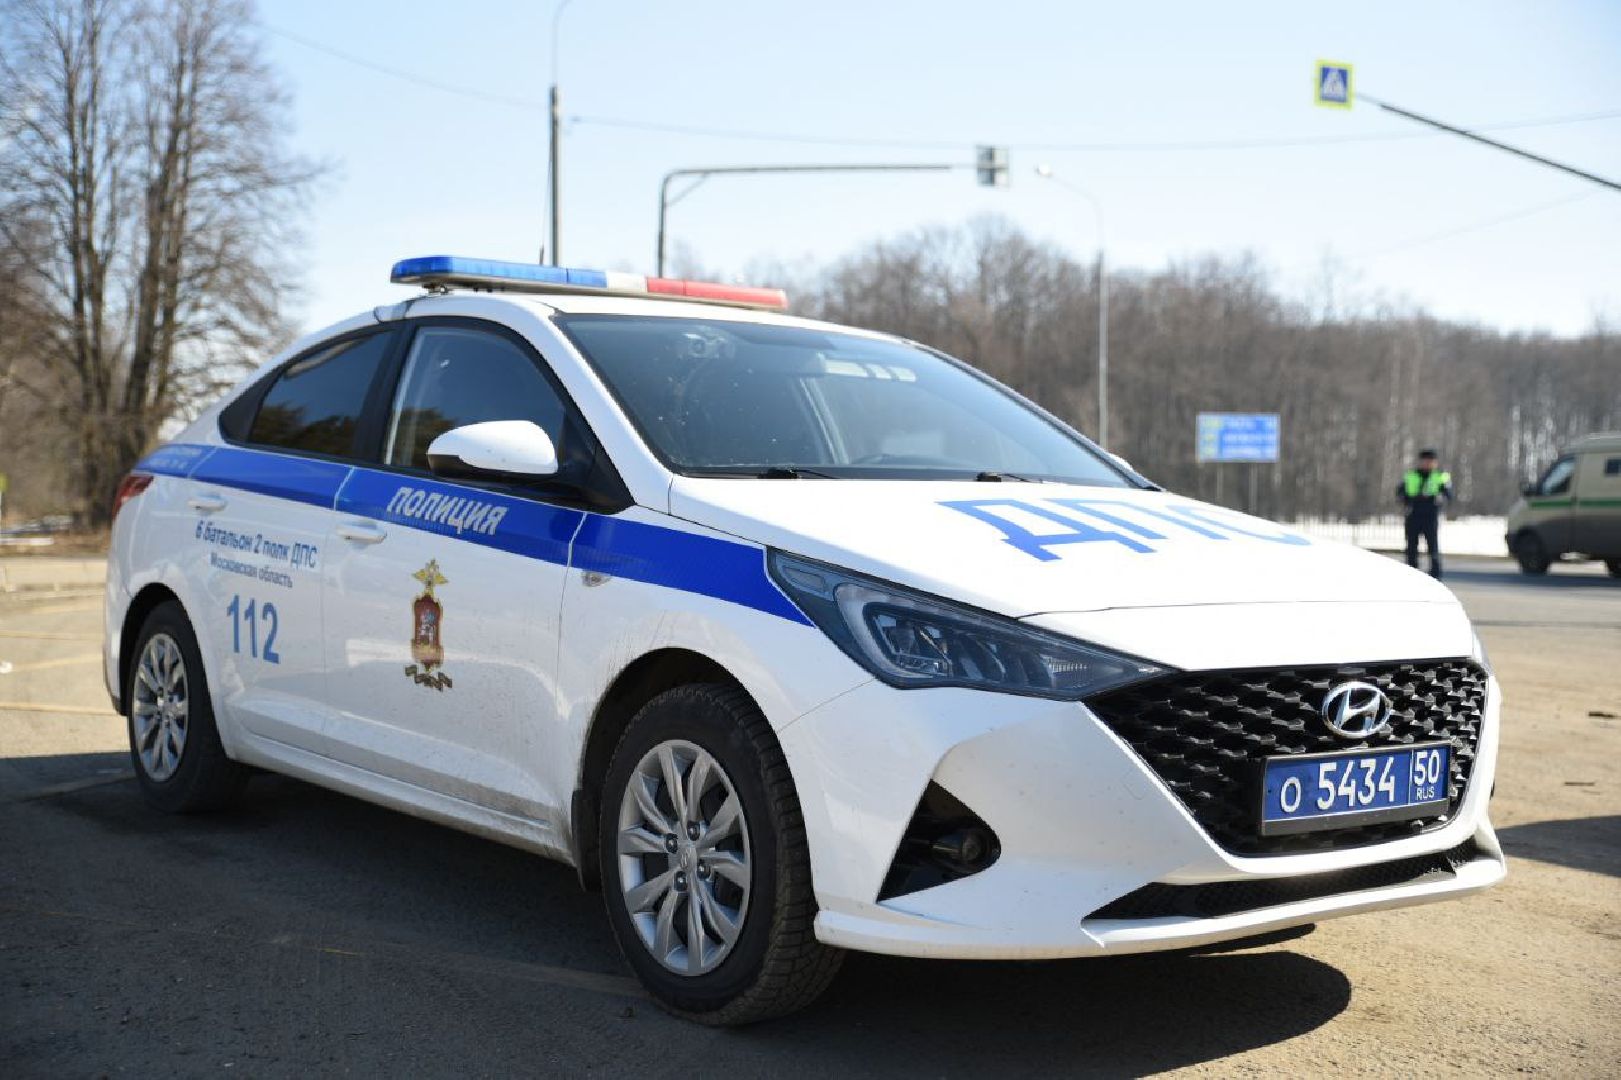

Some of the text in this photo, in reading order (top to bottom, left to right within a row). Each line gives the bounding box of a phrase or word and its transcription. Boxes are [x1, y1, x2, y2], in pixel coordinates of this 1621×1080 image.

[386, 486, 508, 536] ПОЛИЦИЯ
[935, 498, 1312, 563] ДПС
[195, 520, 318, 570] 6 батальон 2 полк ДПС
[210, 552, 293, 588] Московская область
[227, 594, 280, 665] 112
[1317, 757, 1396, 811] 5434
[1413, 749, 1441, 787] 50
[1416, 786, 1436, 800] RUS
